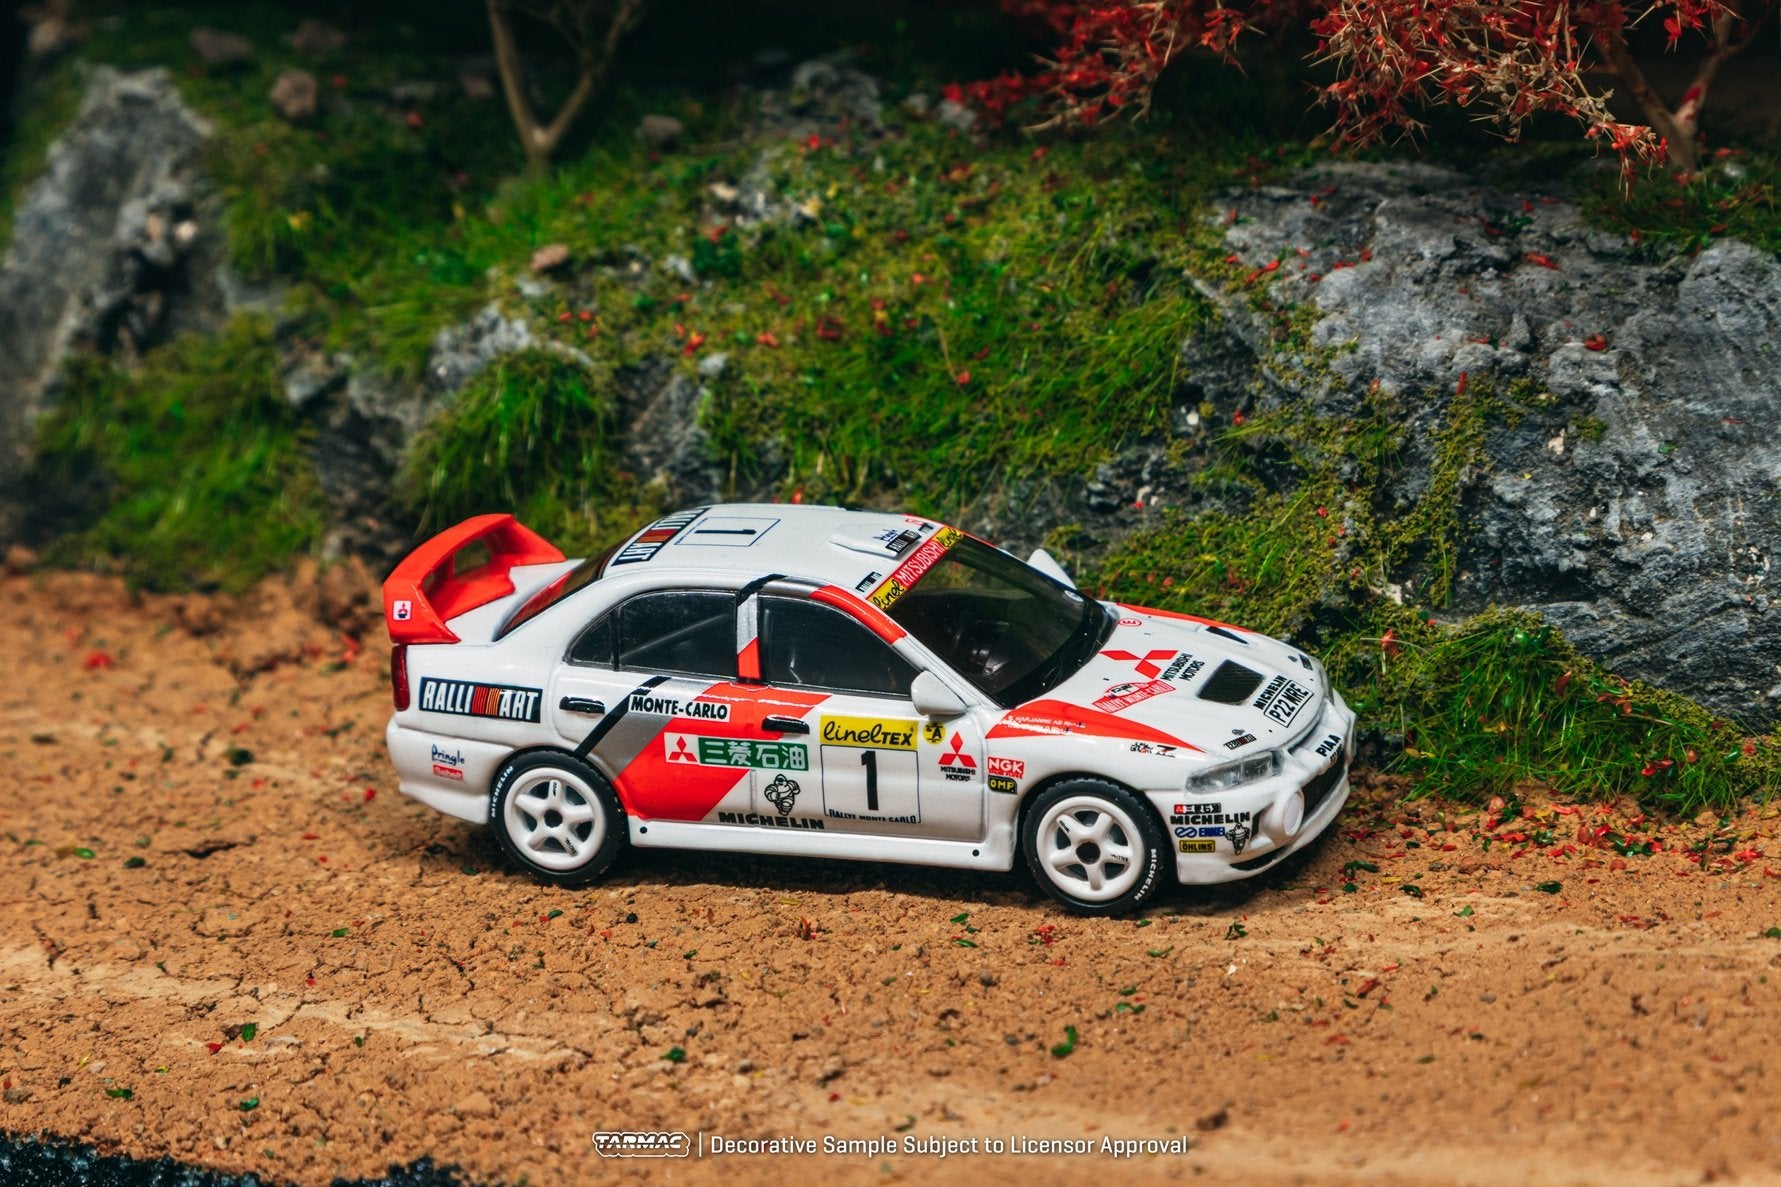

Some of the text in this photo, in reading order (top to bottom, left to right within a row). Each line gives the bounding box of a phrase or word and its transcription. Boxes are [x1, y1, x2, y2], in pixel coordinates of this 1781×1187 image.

[895, 541, 944, 587] MITSUBISHI
[1253, 675, 1288, 710] MICHELIN
[631, 695, 728, 720] MONTE-CARLO
[1268, 698, 1297, 723] P22
[431, 744, 466, 766] Pringle
[704, 741, 806, 769] 三菱石油
[1315, 734, 1342, 758] PIAA
[940, 766, 976, 776] MITSUBISHI
[988, 758, 1024, 774] NGK
[491, 766, 514, 818] MICHELIN
[860, 750, 879, 811] 1
[718, 812, 825, 830] MICHELIN
[828, 809, 857, 820] RALLYE
[1170, 812, 1250, 825] MICHELIN
[1134, 848, 1157, 901] MICHELIN
